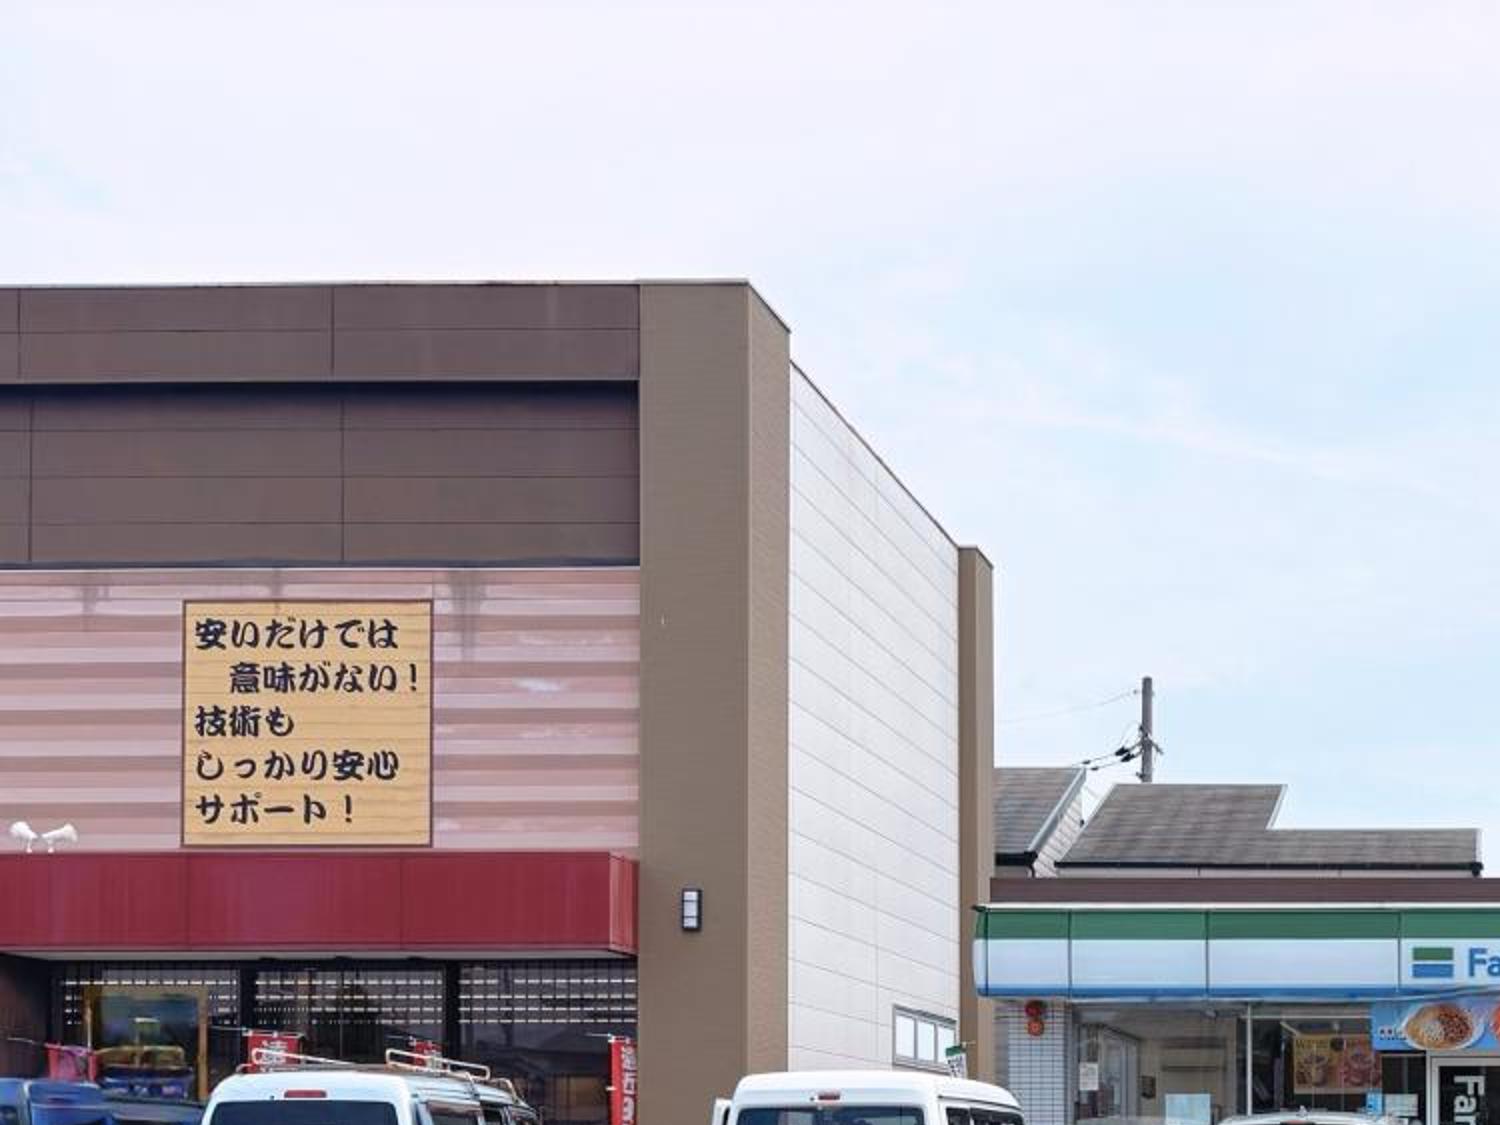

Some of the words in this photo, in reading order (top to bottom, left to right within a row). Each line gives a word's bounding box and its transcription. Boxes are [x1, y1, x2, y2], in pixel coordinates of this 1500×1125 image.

[195, 618, 399, 650] 安いだけでは
[229, 661, 417, 694] 意味がない！
[195, 705, 294, 737] 技術も
[196, 750, 399, 781] しっかり安心
[195, 792, 353, 825] サポート！
